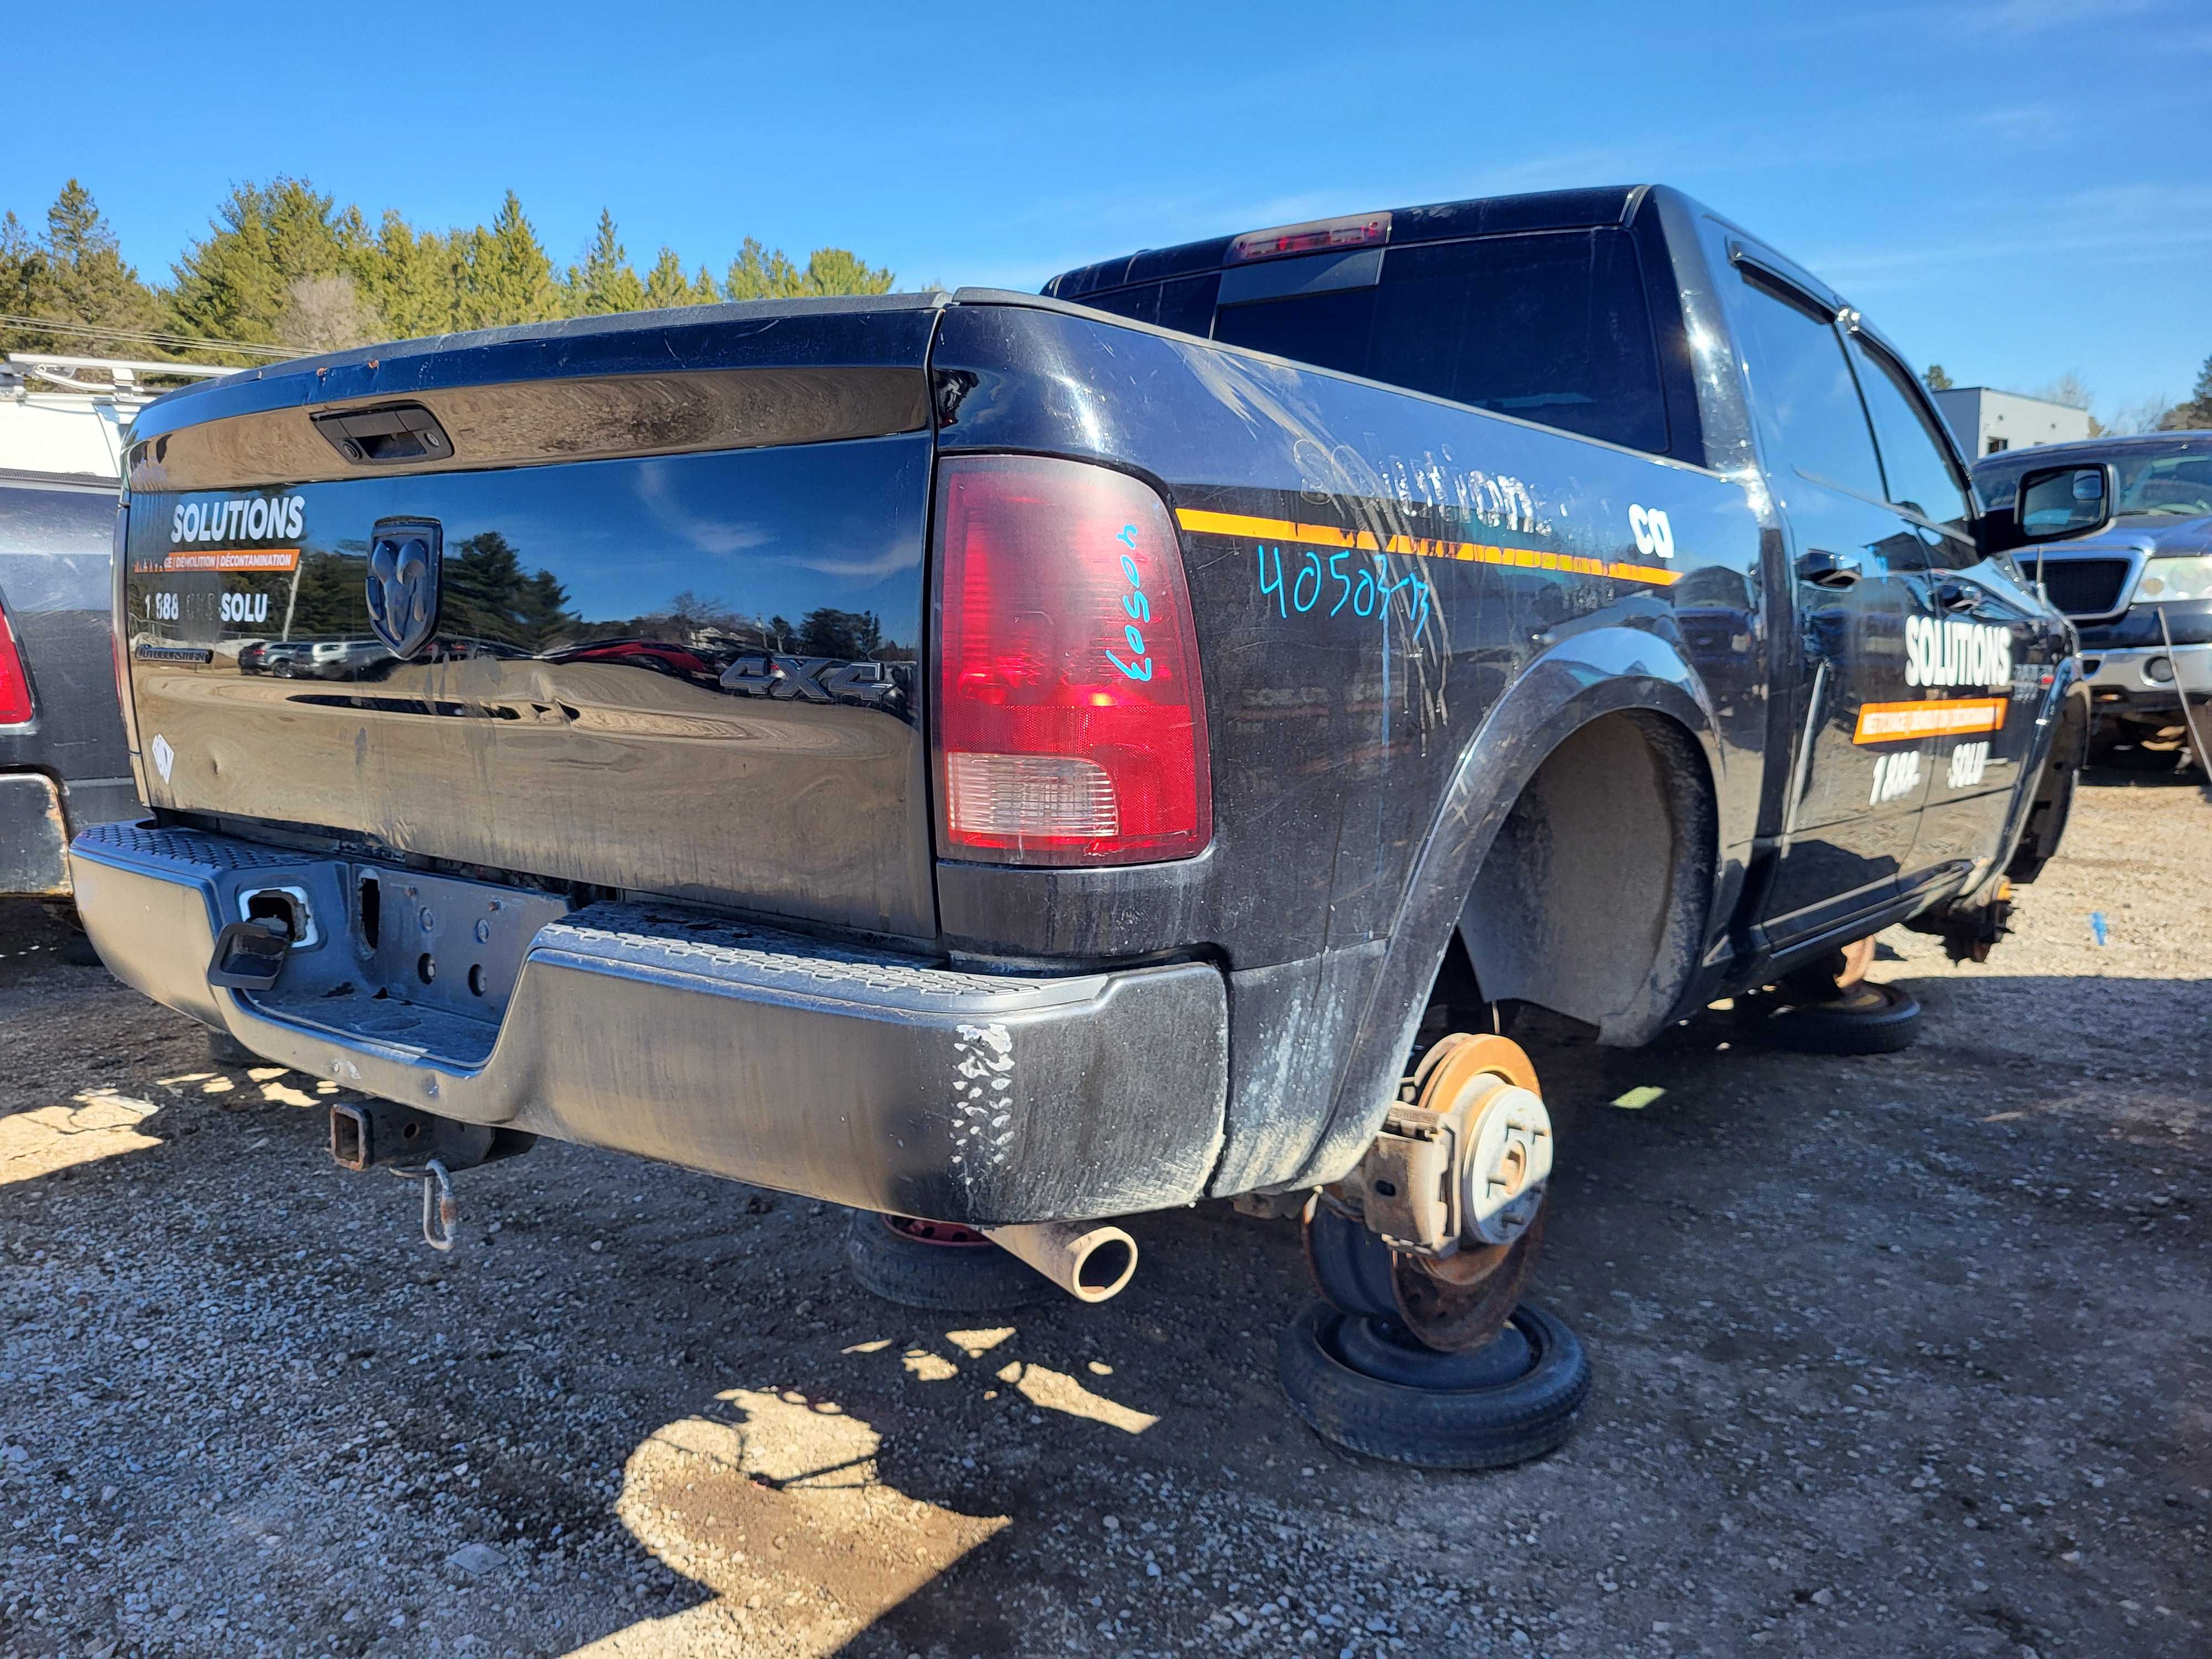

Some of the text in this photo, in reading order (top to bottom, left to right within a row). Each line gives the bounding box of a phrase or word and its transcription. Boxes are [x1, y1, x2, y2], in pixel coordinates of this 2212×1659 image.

[171, 496, 305, 543] SOLUTIONS
[176, 555, 216, 568] DÉMOLITION
[220, 552, 291, 567] DÉCONTAMINATION
[221, 592, 268, 623] SOLU
[1105, 524, 1152, 681] 40503
[1904, 615, 2012, 686] SOLUTIONS
